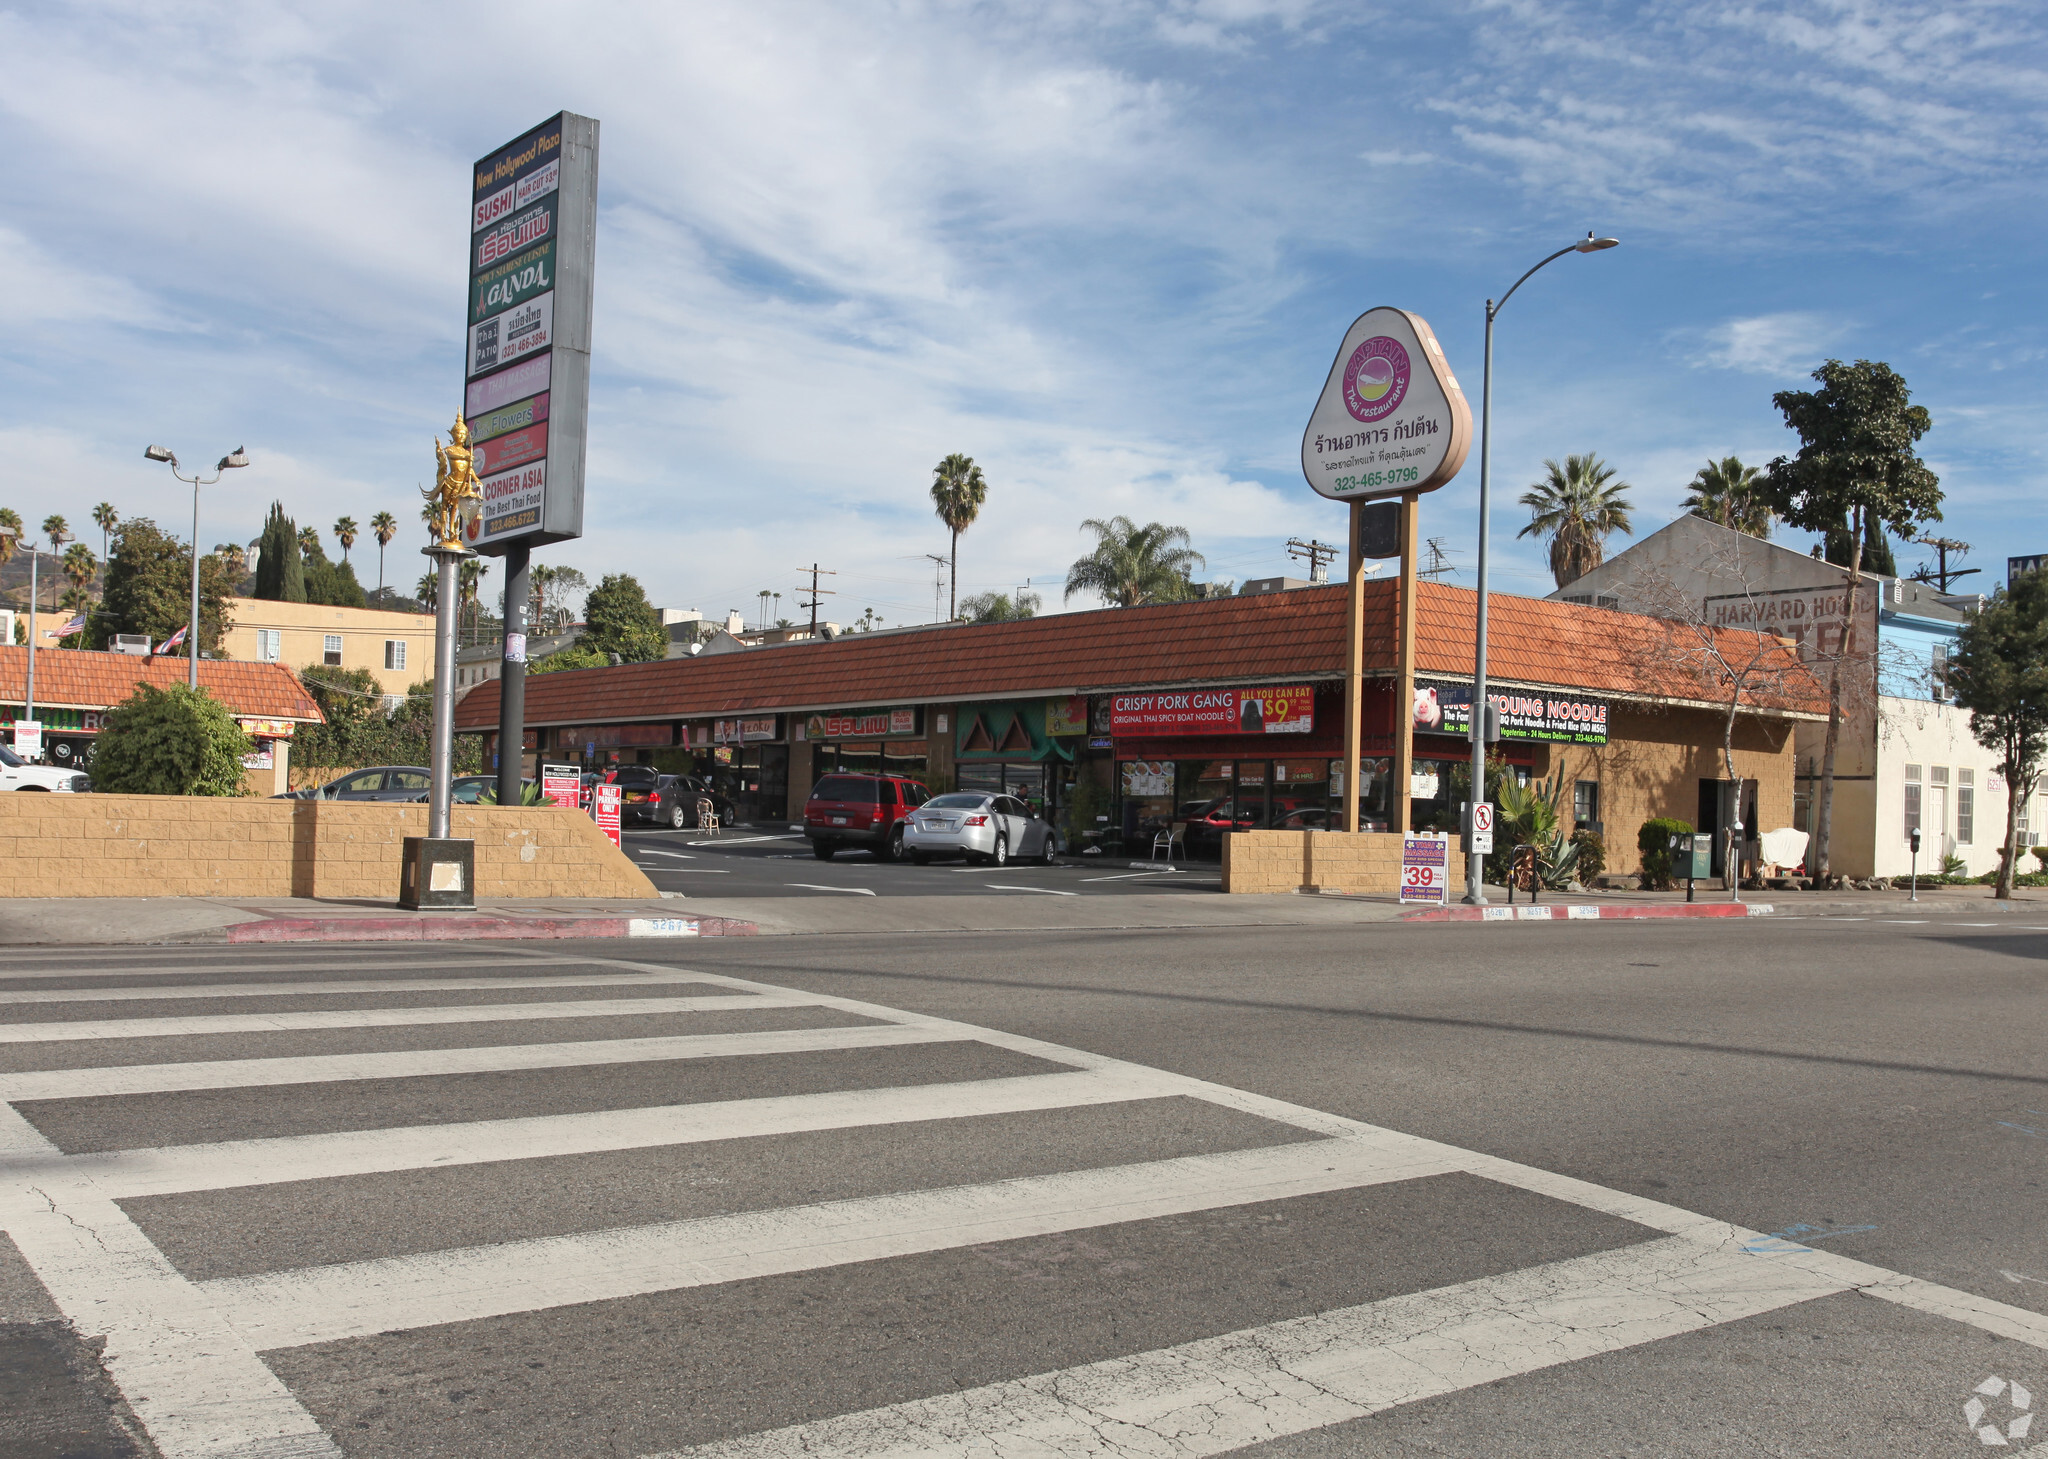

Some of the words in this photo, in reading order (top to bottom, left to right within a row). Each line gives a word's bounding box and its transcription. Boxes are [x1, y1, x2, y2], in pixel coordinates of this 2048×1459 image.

[476, 171, 494, 192] New
[495, 141, 537, 178] Hollywood
[538, 132, 560, 156] Plaza
[517, 184, 532, 200] HAIR
[532, 177, 545, 192] CUT
[477, 190, 513, 226] SUSHI
[501, 205, 544, 234] ห้องอาหาร
[478, 210, 550, 268] เรือนแพ
[487, 260, 550, 306] GANDA
[478, 324, 499, 344] Thai
[501, 343, 517, 361] (323)
[517, 330, 547, 352] 466-3894
[476, 344, 498, 361] PATIO
[1346, 338, 1408, 382] CAPTAIN
[1346, 385, 1362, 412] Thai
[1359, 376, 1405, 417] restaurant
[491, 407, 533, 433] Flowers
[1315, 428, 1389, 454] ร้านอาหาร
[1393, 415, 1439, 441] กัปตัน
[485, 474, 520, 502] CORNER
[521, 467, 543, 491] ASIA
[1334, 466, 1419, 492] 323-465-9796
[485, 505, 496, 518] The
[497, 500, 511, 514] Best
[511, 495, 525, 510] Thai
[526, 490, 541, 506] Food
[1715, 598, 1806, 625] HARVARD
[1115, 696, 1154, 711] CRISPY
[1157, 694, 1190, 710] PORK
[1193, 692, 1234, 709] GANG
[1240, 690, 1255, 700] ALL
[1256, 689, 1274, 699] YOU
[1275, 688, 1293, 698] CAN
[1295, 687, 1311, 697] EAT
[1113, 714, 1142, 724] ORIGINAL
[1143, 714, 1158, 723] THAI
[1159, 713, 1176, 723] SPICY
[1177, 713, 1194, 722] BOAT
[1195, 711, 1225, 721] NOODLE
[1488, 694, 1544, 718] YOUNG
[1547, 700, 1607, 723] NOODLE
[1443, 722, 1455, 731] Rice
[1530, 729, 1537, 738] 24
[1537, 730, 1552, 739] Hours
[1552, 731, 1573, 742] Delivery
[1575, 733, 1607, 744] 323-465-9796
[1444, 709, 1456, 720] The
[1510, 715, 1524, 726] Pork
[1525, 717, 1545, 728] Noodle
[1546, 720, 1551, 729] &
[1551, 720, 1567, 731] Fried
[1567, 721, 1579, 732] Rice
[1591, 723, 1607, 735] MSG)
[598, 795, 620, 805] PARKING
[602, 787, 617, 797] VALET
[602, 804, 615, 813] ONLY
[1404, 849, 1445, 857] MASSAGE
[1415, 841, 1436, 849] THAI
[1403, 866, 1433, 886] $39
[652, 919, 684, 932] 5267
